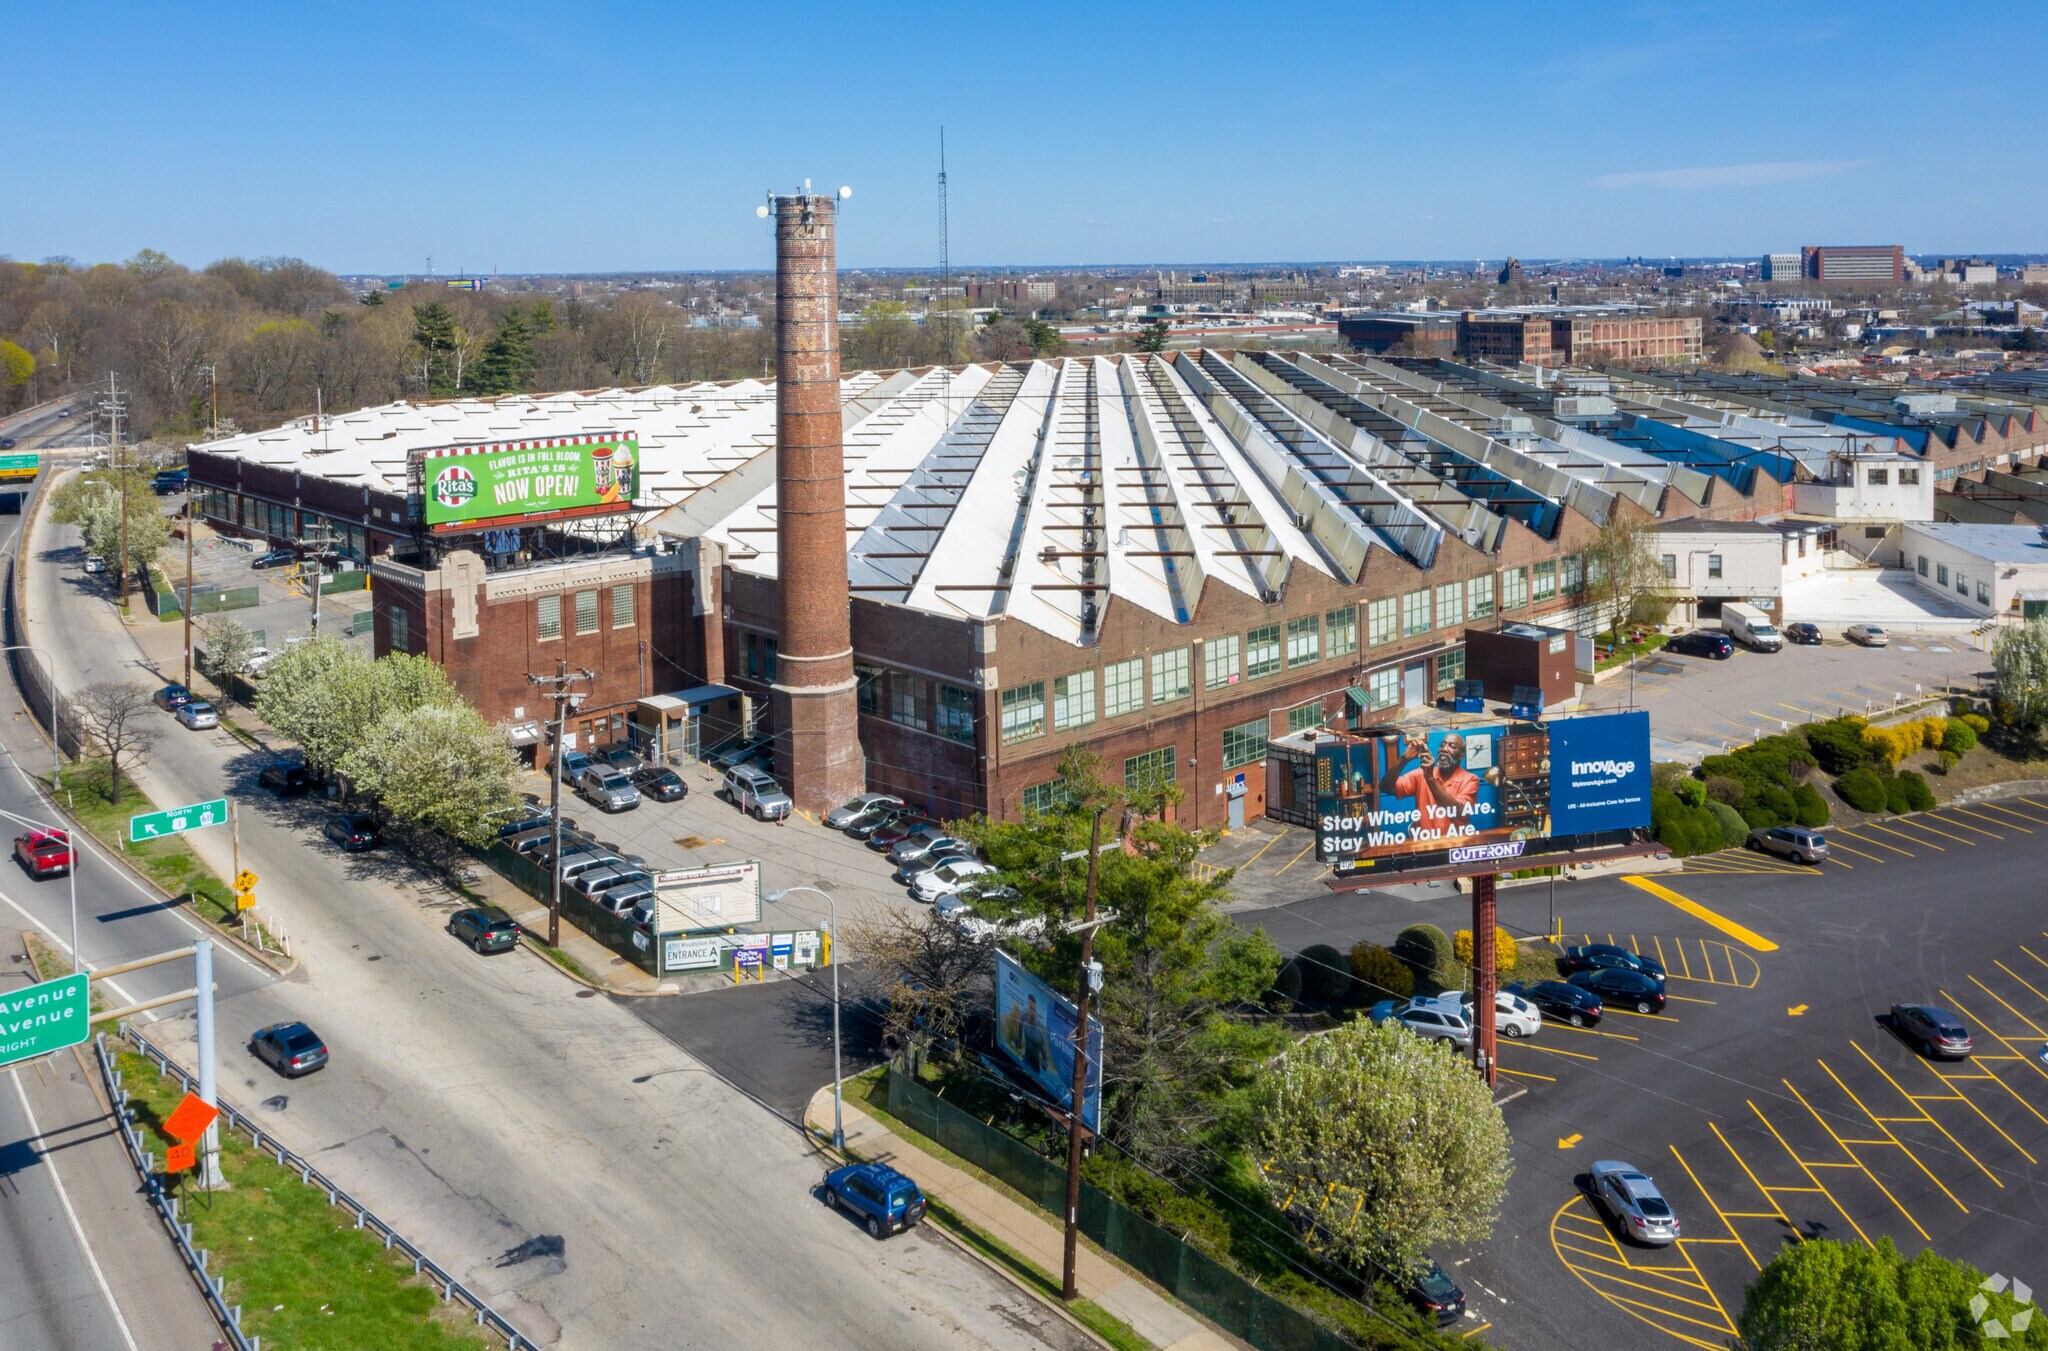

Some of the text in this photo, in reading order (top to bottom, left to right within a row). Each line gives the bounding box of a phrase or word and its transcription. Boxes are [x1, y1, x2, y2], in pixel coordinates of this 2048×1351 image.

[488, 455, 516, 471] FLAVOR
[517, 453, 526, 464] IS
[527, 452, 535, 463] IN
[537, 451, 554, 462] FULL
[507, 464, 566, 478] RITA'S IS
[437, 479, 474, 496] Rita's
[493, 474, 579, 506] NOW OPEN!
[166, 808, 192, 818] NORTH
[1323, 801, 1496, 832] Stay Where You Are.
[1323, 823, 1480, 853] Stay Who You Are.
[1452, 844, 1519, 861] OUTFRONT
[668, 947, 718, 960] ENTRANCE A
[0, 986, 77, 1015] Avenue
[0, 1007, 74, 1036] Avenue
[0, 1036, 37, 1054] RIGHT
[171, 1147, 190, 1159] 40
